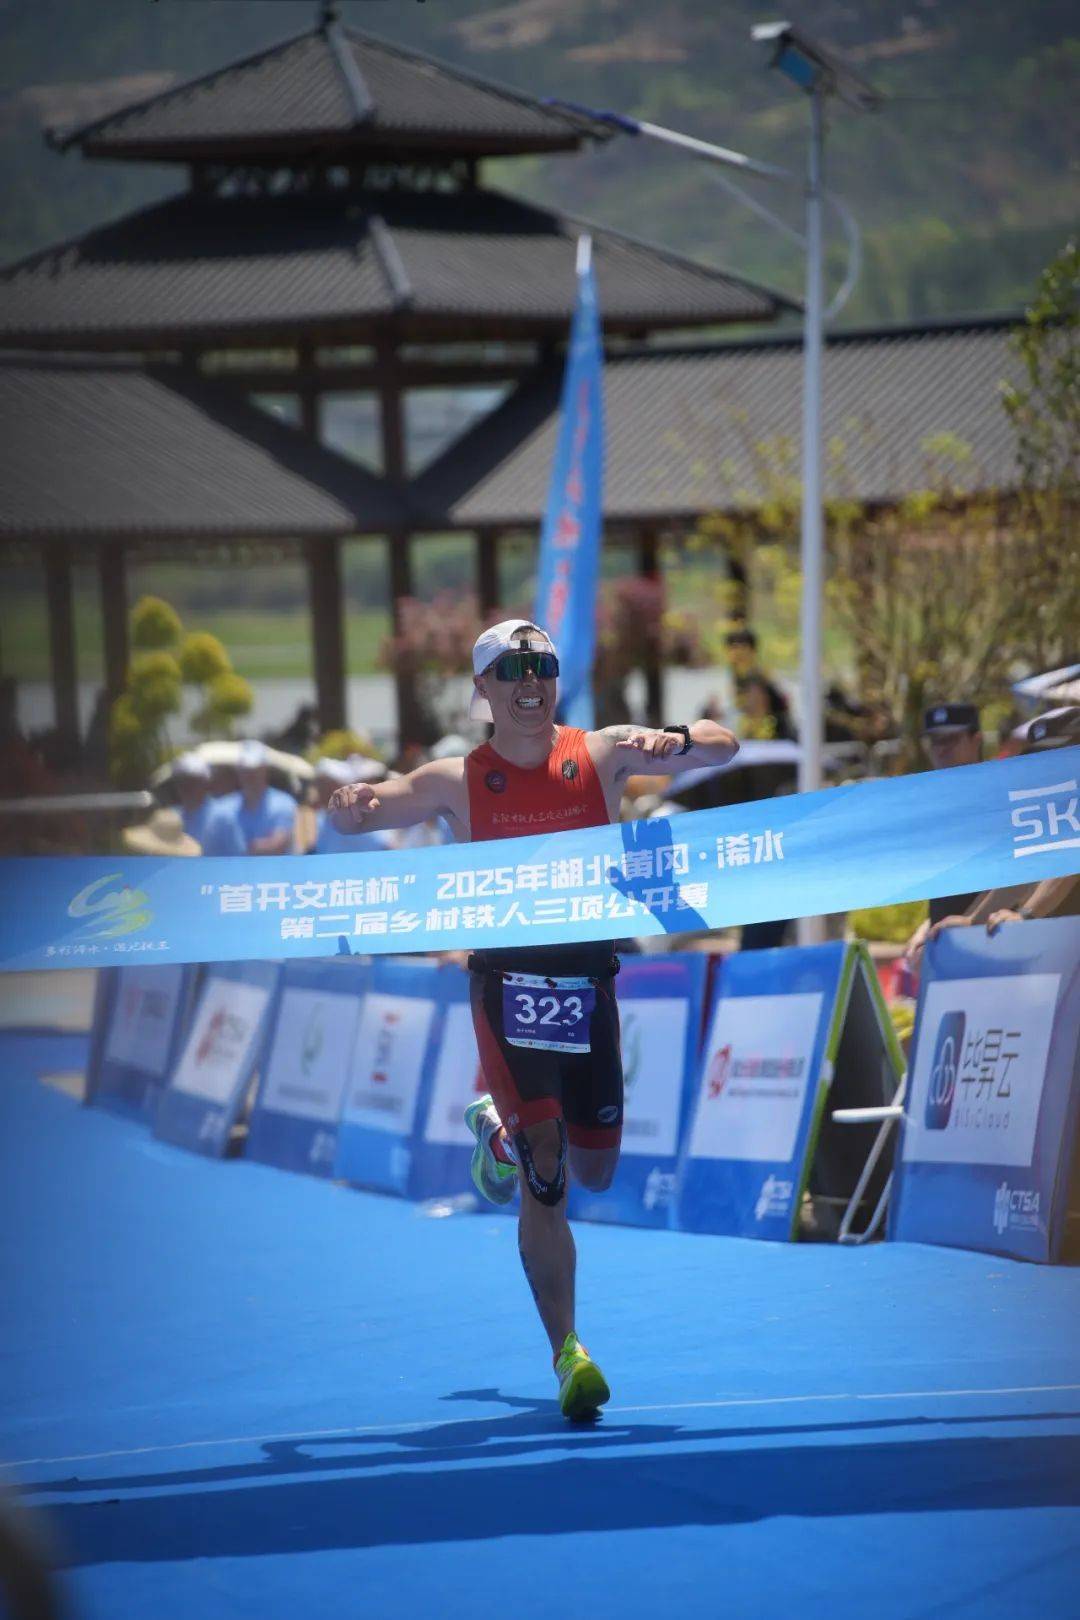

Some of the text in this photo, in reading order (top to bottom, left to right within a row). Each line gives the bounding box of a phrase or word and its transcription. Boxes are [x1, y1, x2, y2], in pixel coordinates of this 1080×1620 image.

[280, 882, 709, 939] 第二届乡村铁人三项公开赛
[515, 994, 584, 1026] 323
